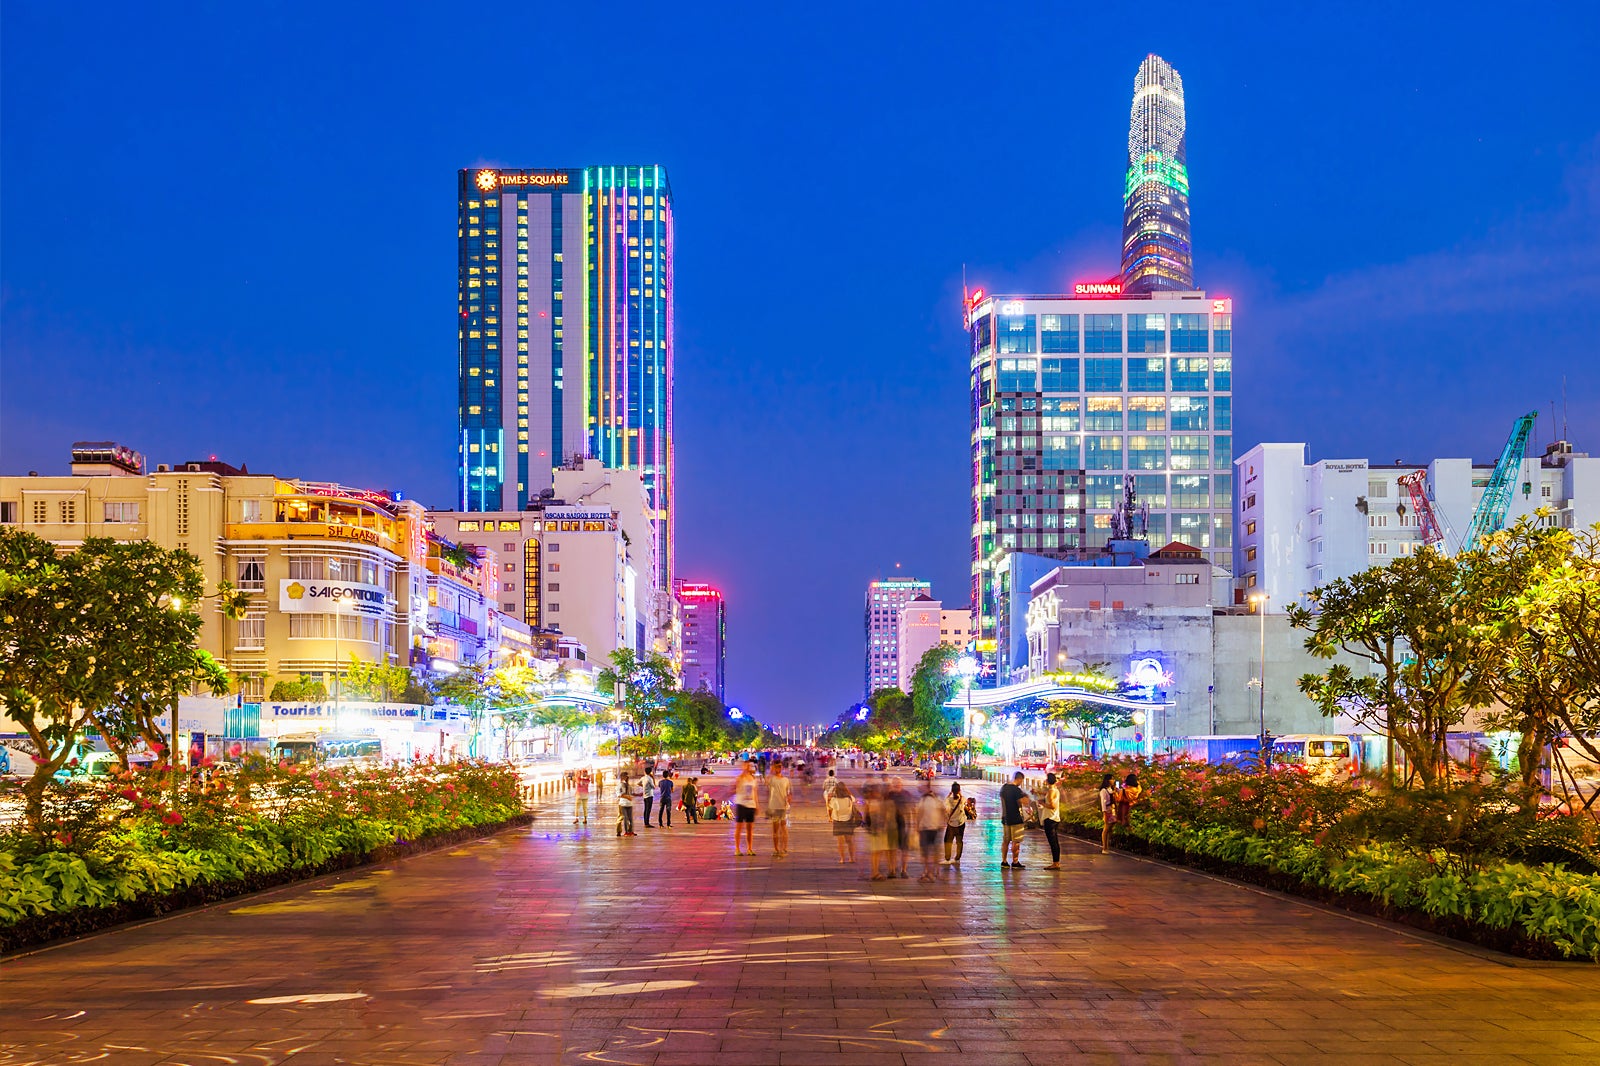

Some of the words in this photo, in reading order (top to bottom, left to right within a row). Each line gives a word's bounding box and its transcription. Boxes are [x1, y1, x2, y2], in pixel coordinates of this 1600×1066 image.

[499, 175, 528, 184] TIMES
[530, 175, 568, 186] SQUARE
[1075, 284, 1121, 294] SUNWAH
[328, 526, 343, 536] SH
[273, 705, 322, 716] Tourist
